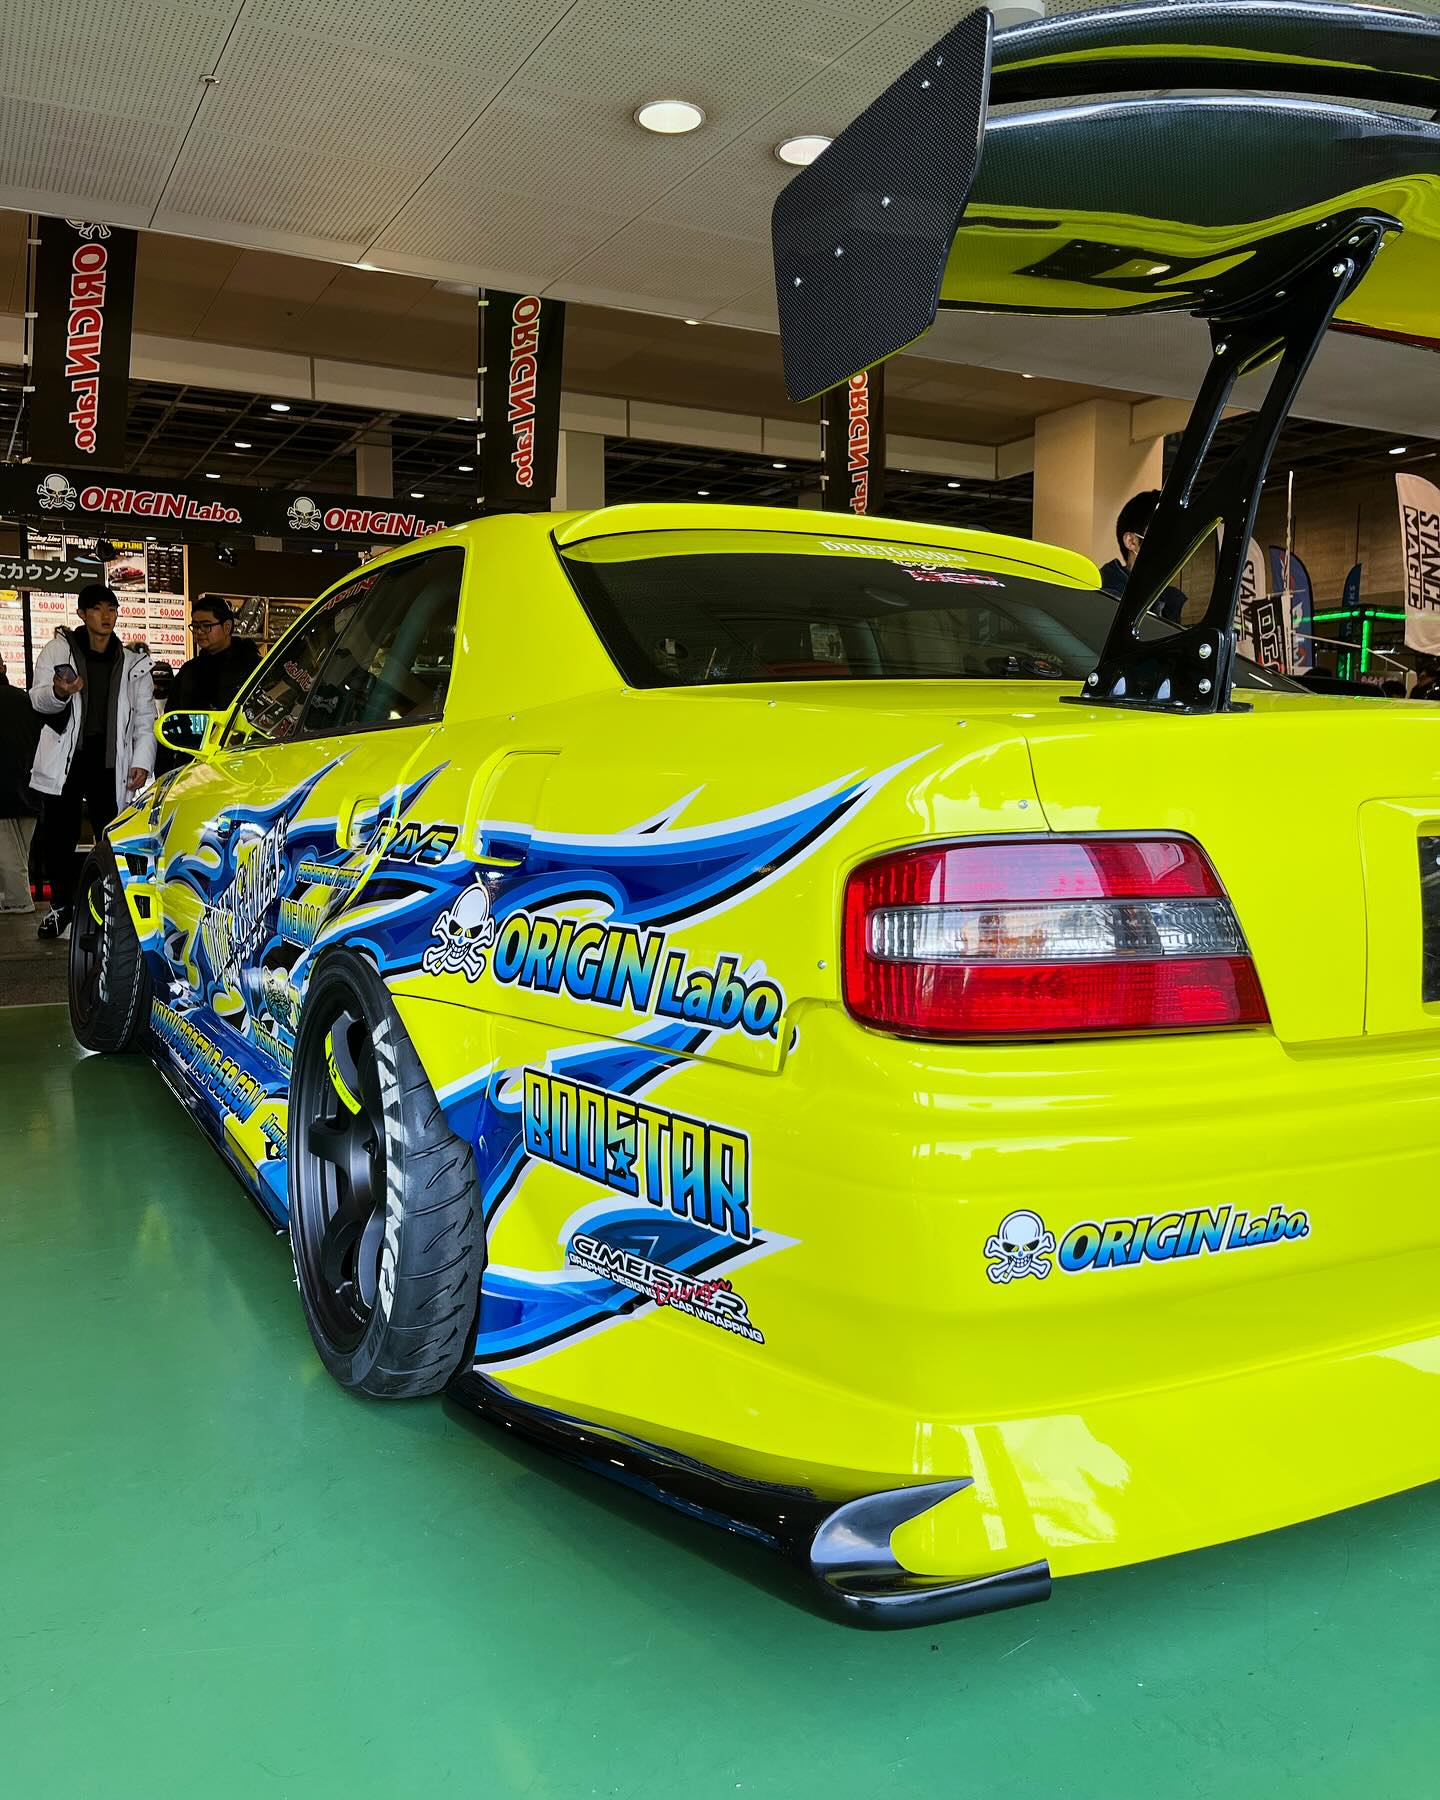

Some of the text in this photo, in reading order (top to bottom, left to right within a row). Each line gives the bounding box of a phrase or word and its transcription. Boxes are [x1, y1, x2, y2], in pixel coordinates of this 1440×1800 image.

[80, 486, 242, 524] ORIGIN Labo.
[324, 508, 415, 538] ORIGIN
[492, 908, 796, 1050] ORIGIN Labo.
[522, 1064, 753, 1245] BOOSTAR
[1057, 1204, 1312, 1274] ORIGIN Labo.
[568, 1252, 611, 1279] GRAPHIC
[668, 1295, 696, 1317] CAR
[693, 1306, 765, 1344] WRAPPING
